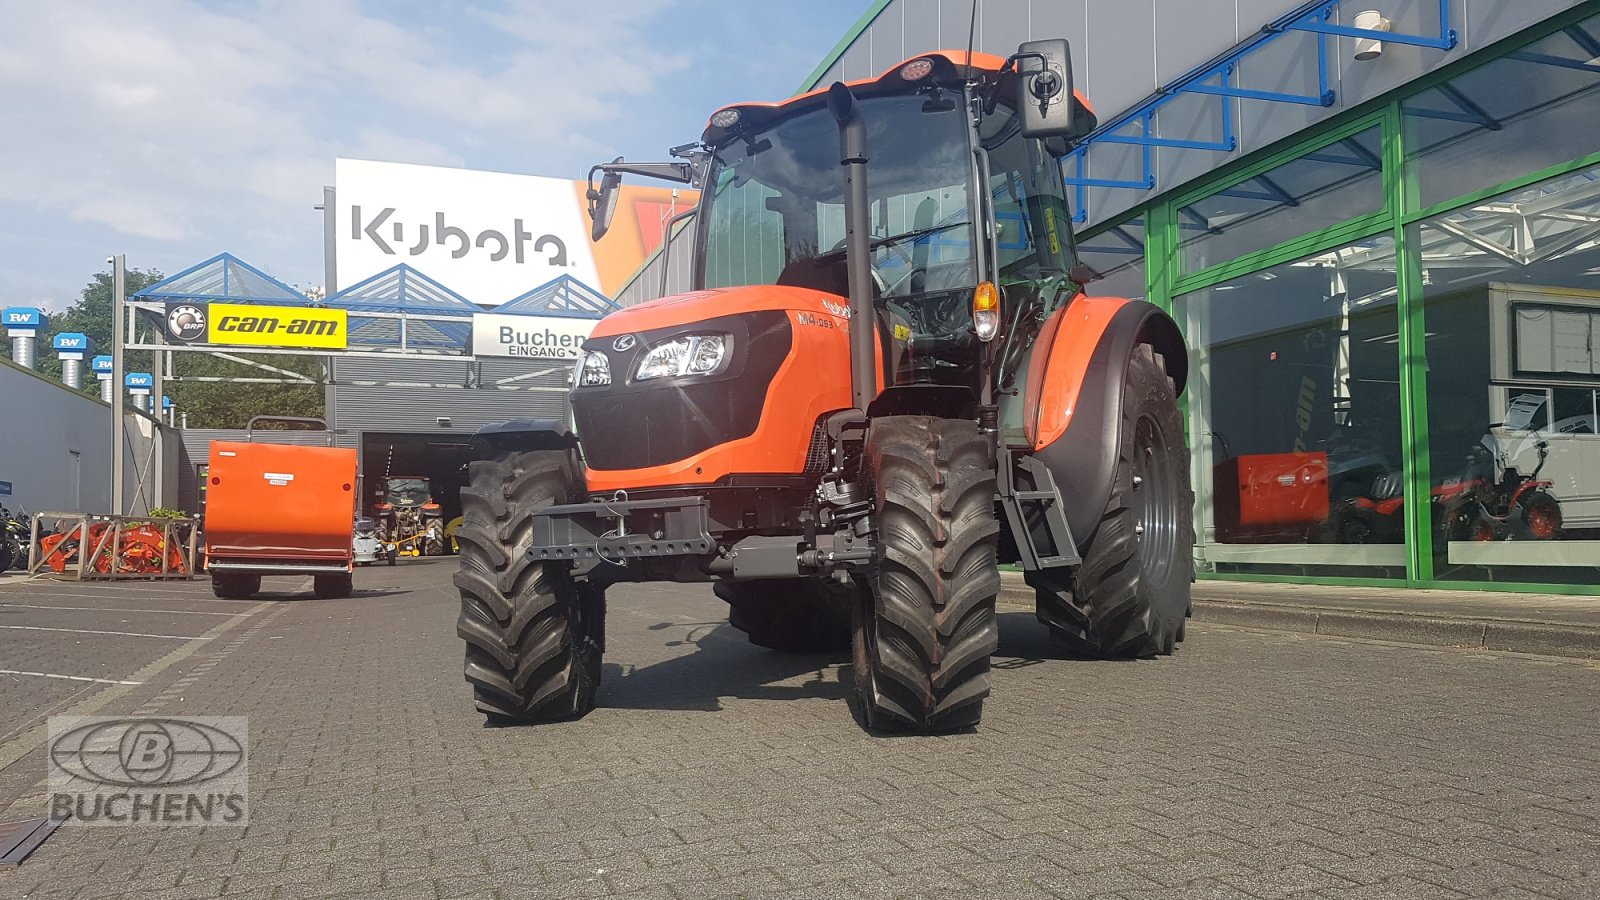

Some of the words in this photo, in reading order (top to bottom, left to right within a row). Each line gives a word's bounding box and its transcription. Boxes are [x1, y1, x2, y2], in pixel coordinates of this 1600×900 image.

[352, 205, 567, 267] Kubota
[217, 316, 338, 336] can-am
[508, 345, 566, 358] EINGANG
